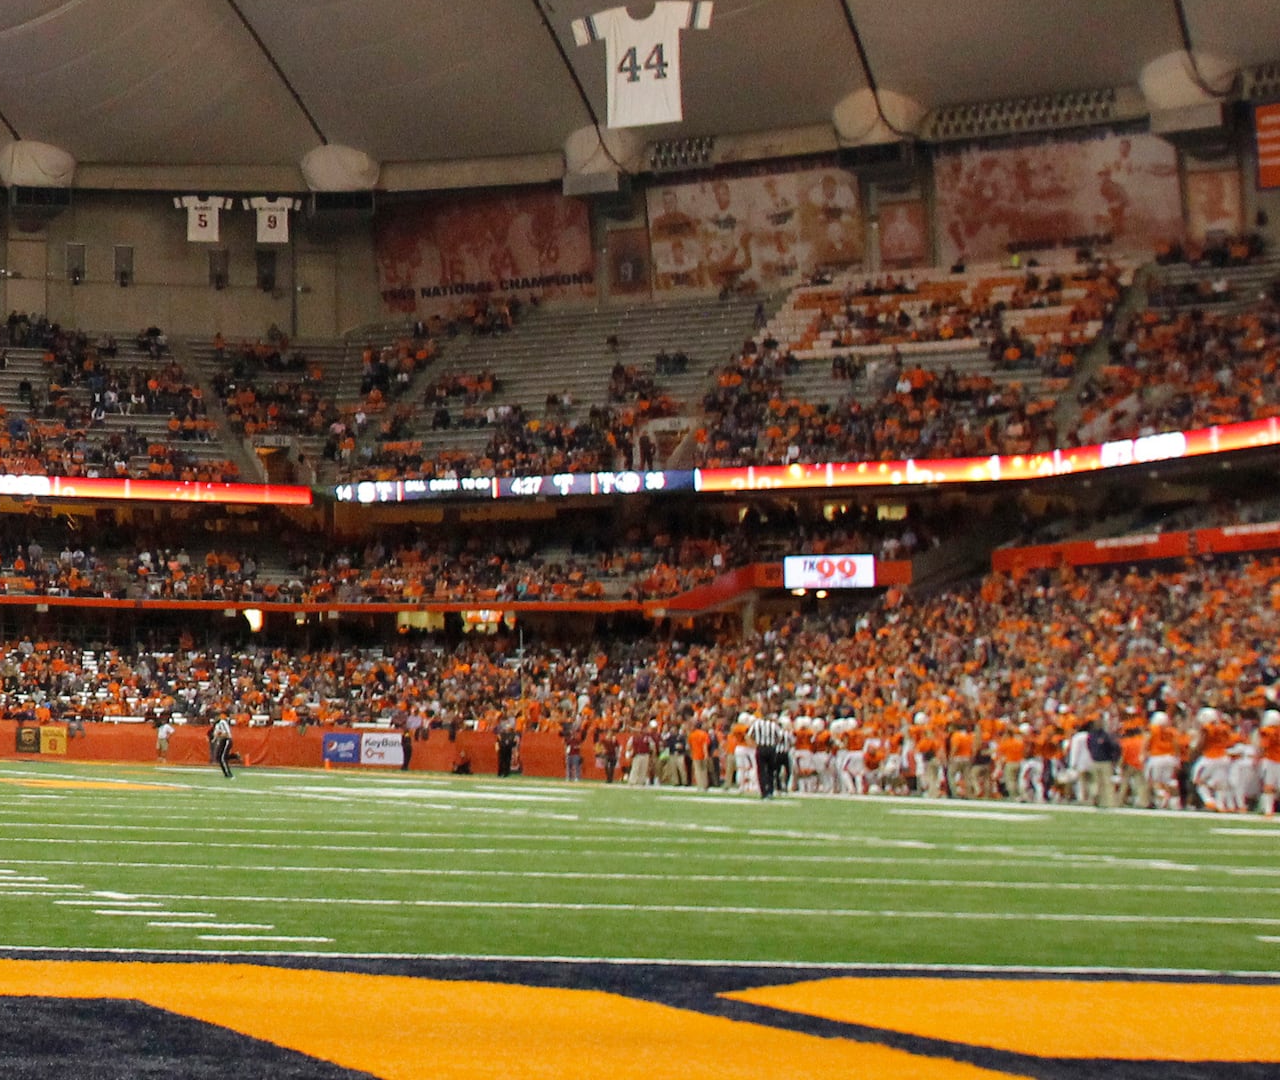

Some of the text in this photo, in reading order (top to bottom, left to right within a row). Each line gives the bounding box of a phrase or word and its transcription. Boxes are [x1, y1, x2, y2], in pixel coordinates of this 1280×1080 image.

[617, 43, 668, 82] 44
[198, 214, 208, 228] 5
[267, 215, 277, 229] 9
[421, 280, 494, 299] NATIONAL
[500, 271, 594, 291] CHAMPIONS
[336, 485, 352, 501] 14
[511, 476, 542, 495] 4:27
